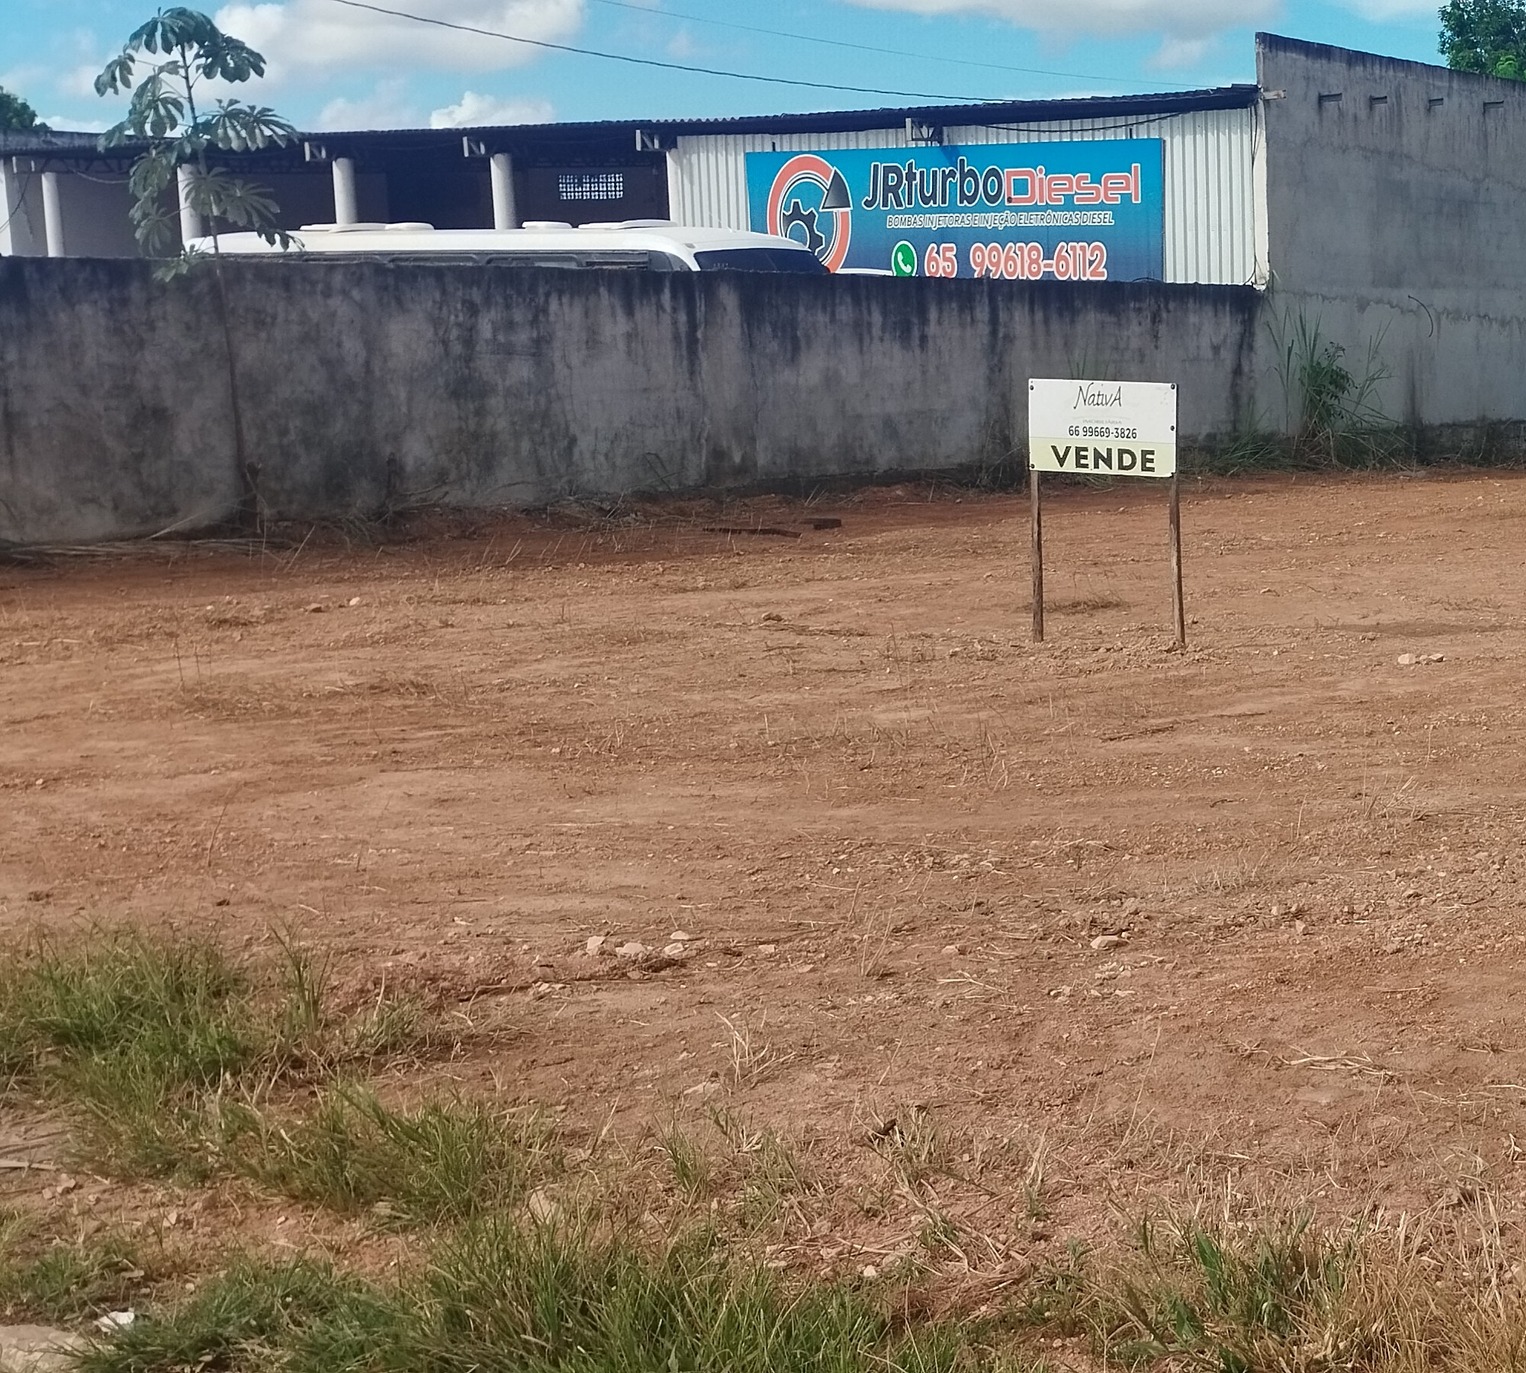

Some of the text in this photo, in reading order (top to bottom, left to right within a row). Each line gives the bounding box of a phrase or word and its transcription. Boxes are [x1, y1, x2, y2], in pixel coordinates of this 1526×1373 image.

[887, 210, 1115, 230] BOMBAS INJETORAS E INJEÇÃO ELETRÔNICAS DIESEL
[925, 242, 1106, 280] 65 99618-6112
[1068, 425, 1138, 439] 66 99669-3826
[1050, 445, 1155, 473] VENDE
